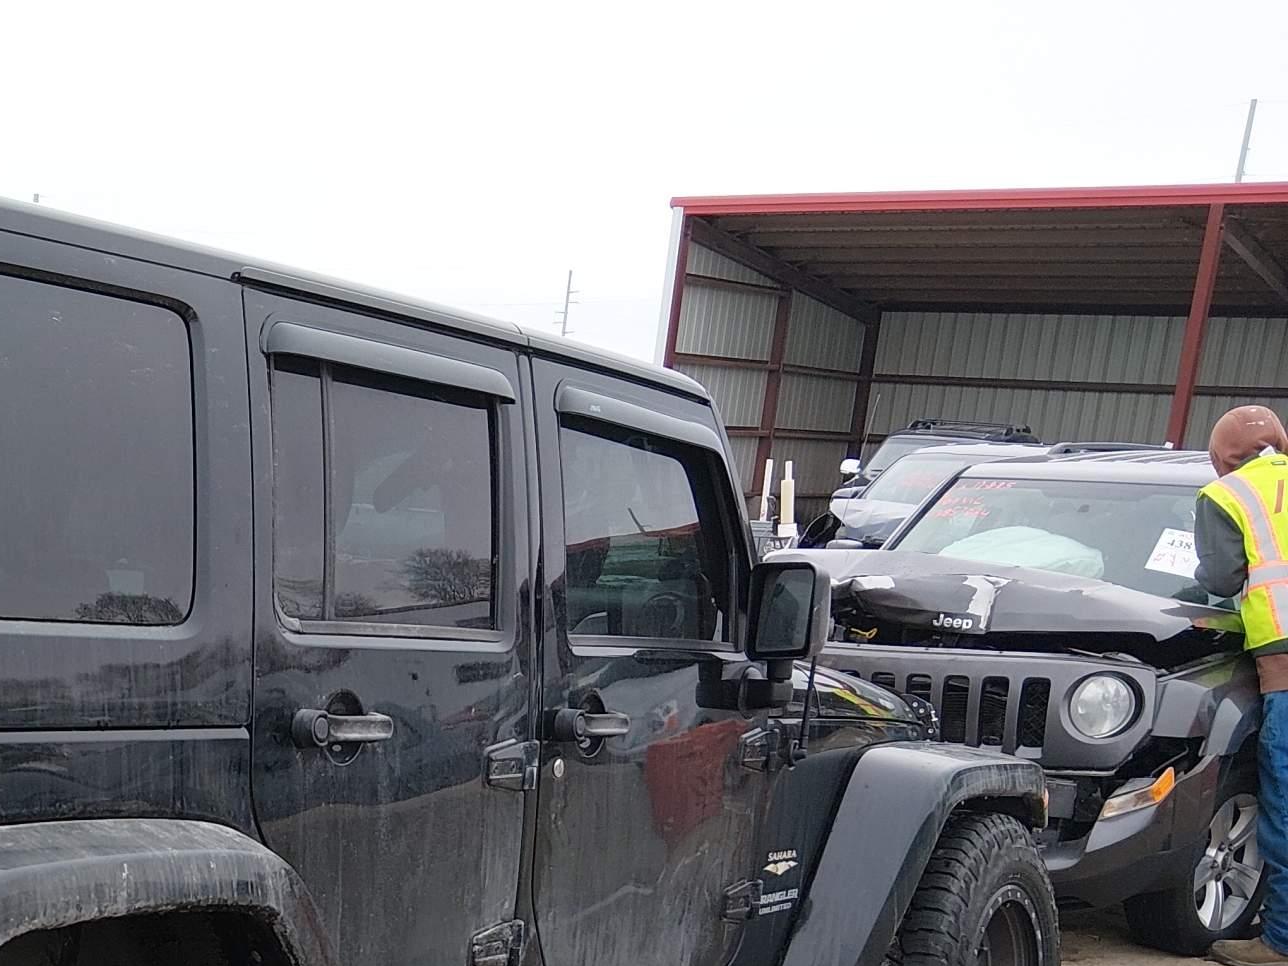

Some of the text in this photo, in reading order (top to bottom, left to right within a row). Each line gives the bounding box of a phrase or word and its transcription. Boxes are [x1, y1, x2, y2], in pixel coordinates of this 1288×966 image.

[932, 613, 973, 630] Jeep
[768, 850, 797, 861] SAHARA
[760, 888, 799, 904] RANGLER
